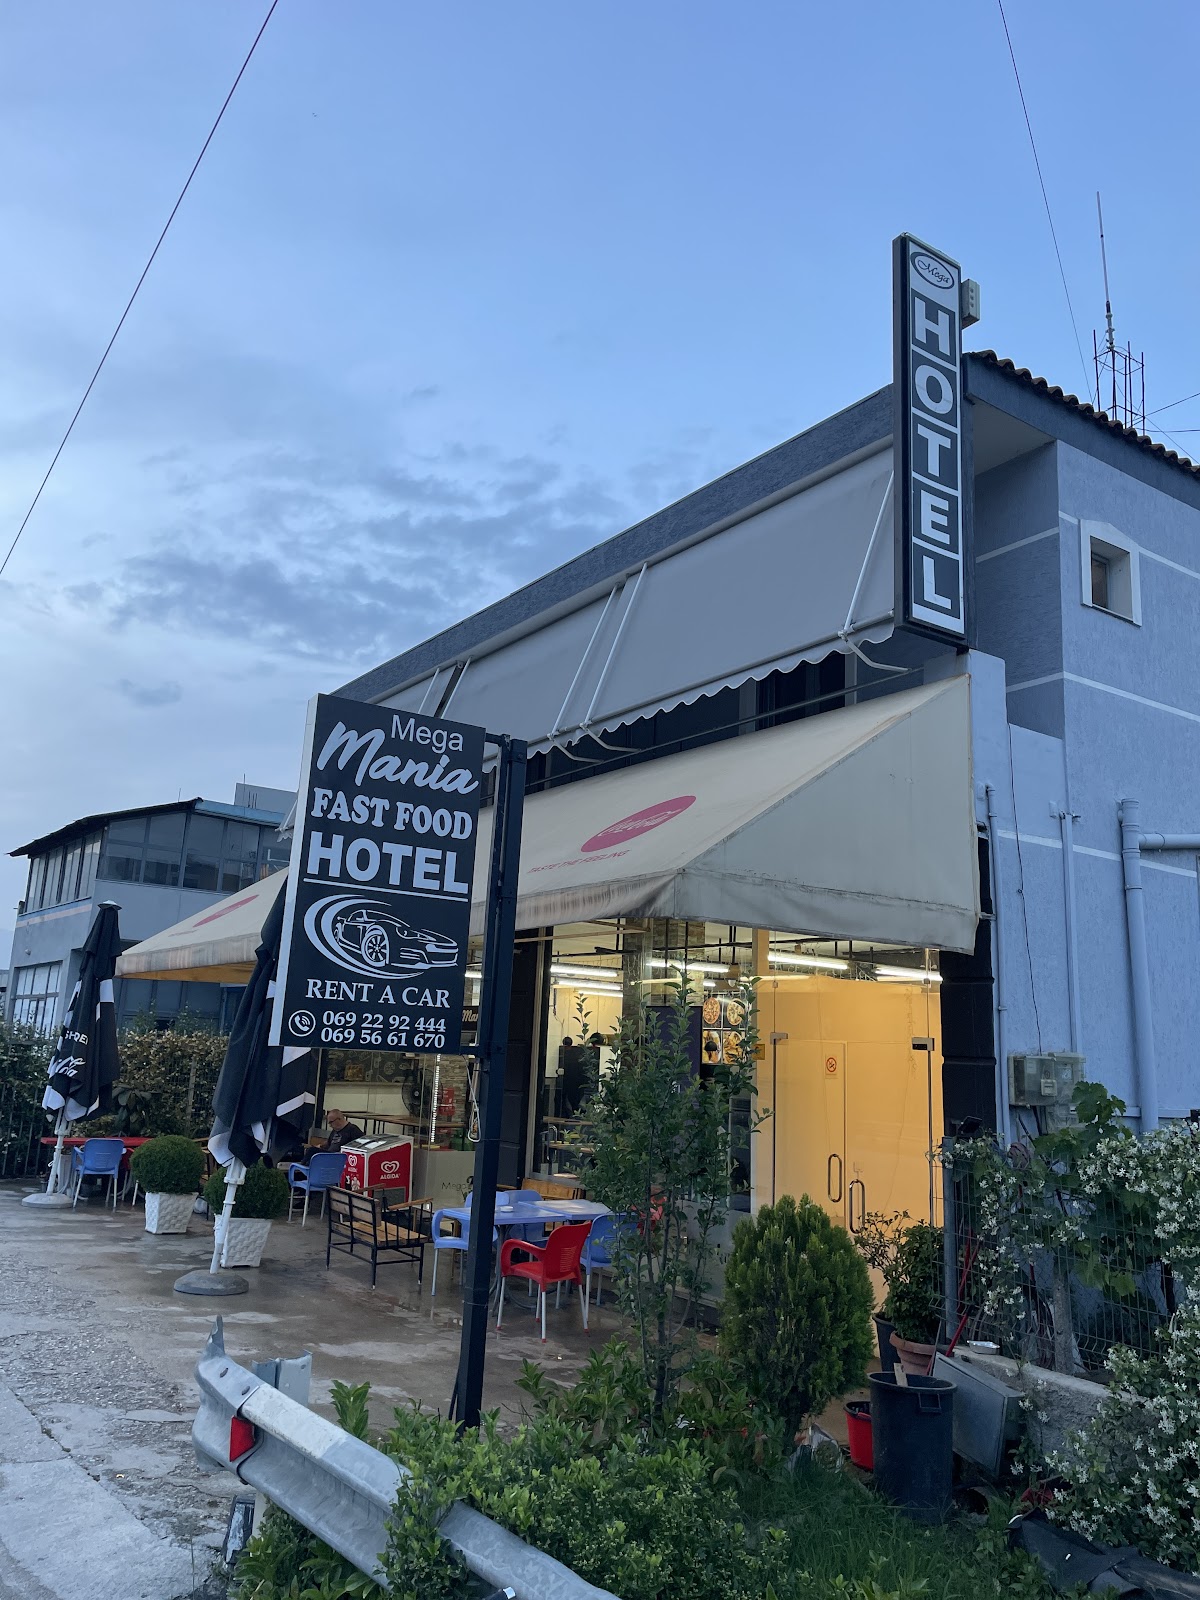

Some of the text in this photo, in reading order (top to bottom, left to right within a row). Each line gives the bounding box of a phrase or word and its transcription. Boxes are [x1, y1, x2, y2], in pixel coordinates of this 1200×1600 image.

[917, 260, 950, 284] Mega
[914, 296, 953, 610] HOTEL
[391, 714, 464, 754] Mega
[316, 721, 479, 795] Mania
[310, 786, 473, 840] FAST FOOD
[306, 830, 469, 894] HOTEL
[305, 978, 451, 1009] RENT A CAR
[320, 1027, 446, 1049] 069 56 61 670
[322, 1010, 447, 1033] 069 22 92 444
